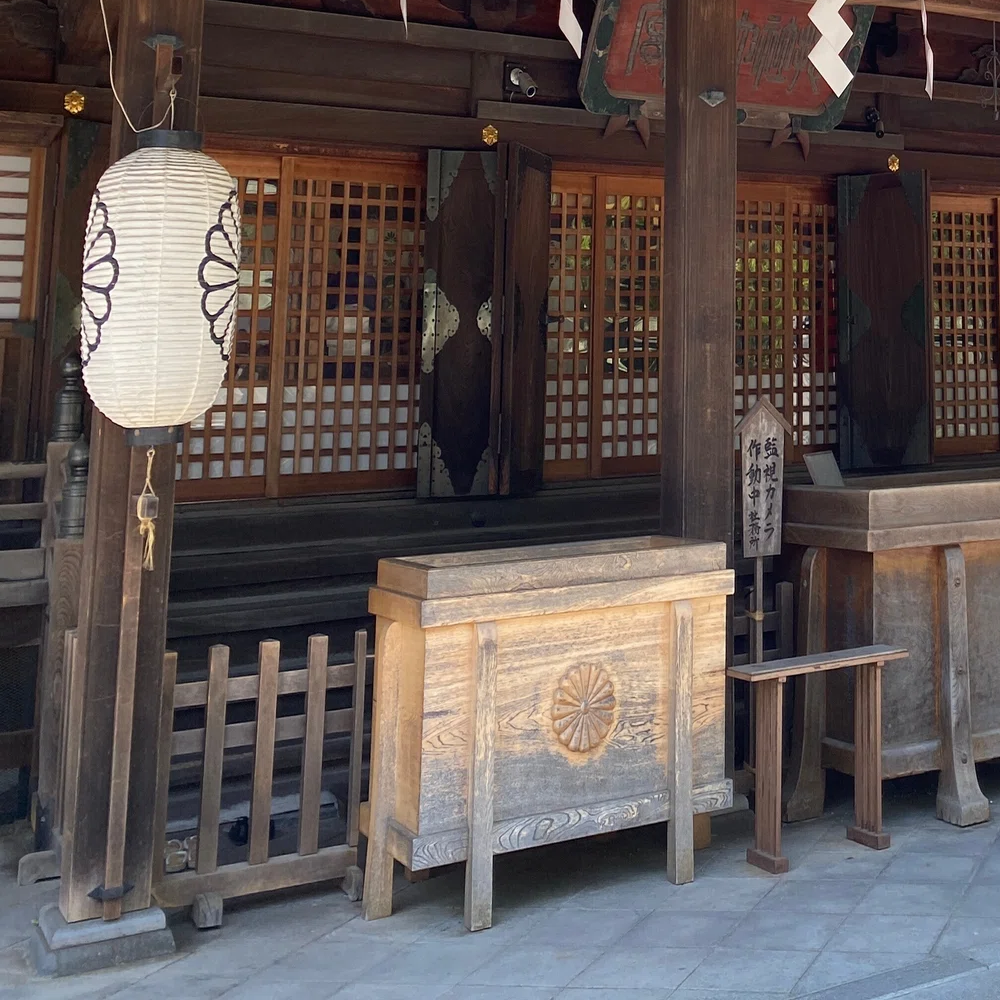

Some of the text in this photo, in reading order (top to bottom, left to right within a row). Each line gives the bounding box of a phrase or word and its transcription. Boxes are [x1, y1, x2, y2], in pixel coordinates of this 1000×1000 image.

[746, 439, 762, 552] 作動中 社務所
[763, 437, 779, 542] 監視カメラ
